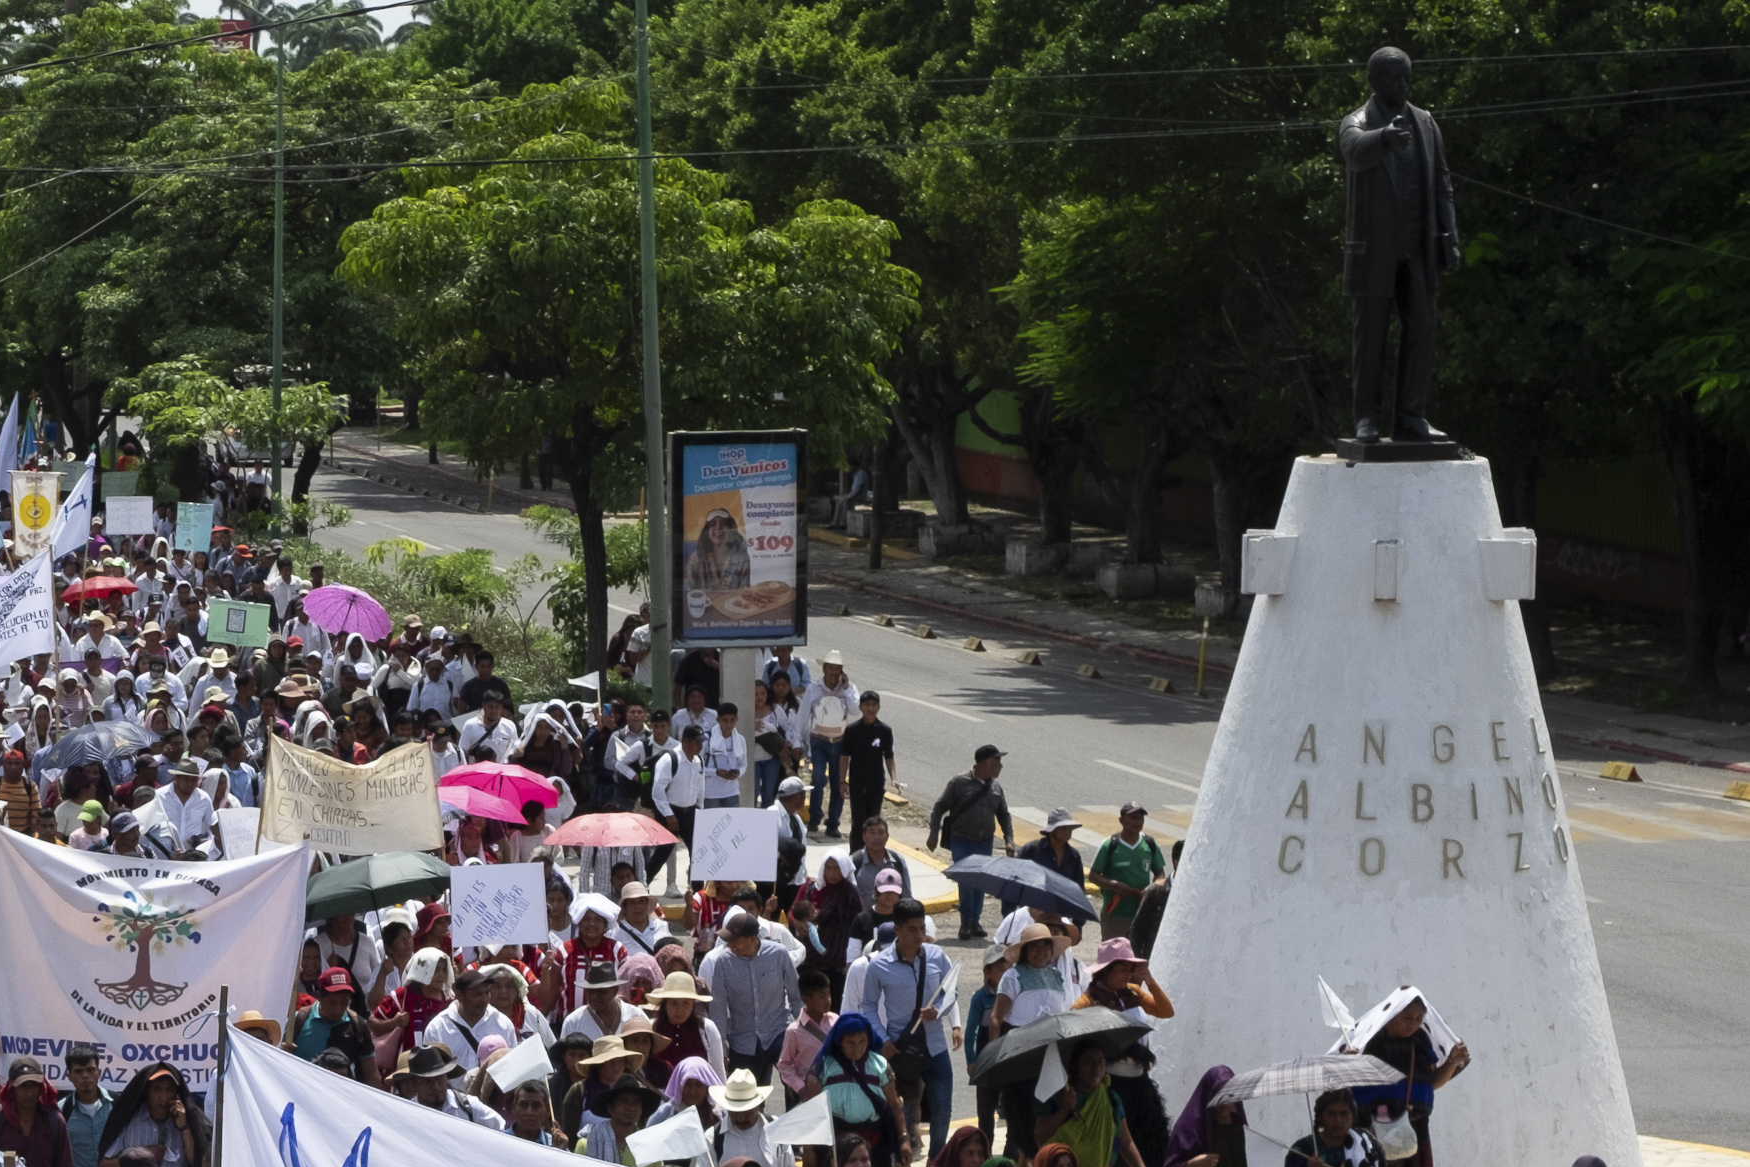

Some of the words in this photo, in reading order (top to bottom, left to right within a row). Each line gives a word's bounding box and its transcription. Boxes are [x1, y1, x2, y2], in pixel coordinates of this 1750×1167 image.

[694, 480, 734, 492] Despertar
[736, 477, 763, 487] cuesta
[746, 501, 795, 510] Desayunos
[747, 509, 794, 518] completos
[747, 535, 794, 553] $109
[39, 609, 49, 618] LA
[21, 624, 28, 633] A
[34, 620, 48, 629] TU
[1295, 716, 1547, 765] ANGEL
[365, 772, 427, 801] MINERAS
[277, 797, 303, 819] EN
[1285, 772, 1557, 824] ALBINO
[311, 827, 350, 846] CENTRO
[731, 830, 747, 849] PAZ
[1277, 826, 1569, 880] CORZO
[75, 867, 148, 888] MOVIMIENTO
[155, 869, 170, 880] EN
[454, 914, 465, 928] LA
[461, 894, 477, 913] PAZ
[472, 879, 486, 894] ES
[507, 884, 524, 906] SER
[70, 989, 84, 1005] DE
[83, 1002, 96, 1018] LA
[96, 1009, 123, 1028] VIDA
[127, 1020, 134, 1029] Y
[137, 1019, 149, 1031] EL
[151, 993, 216, 1031] TERRITORIO
